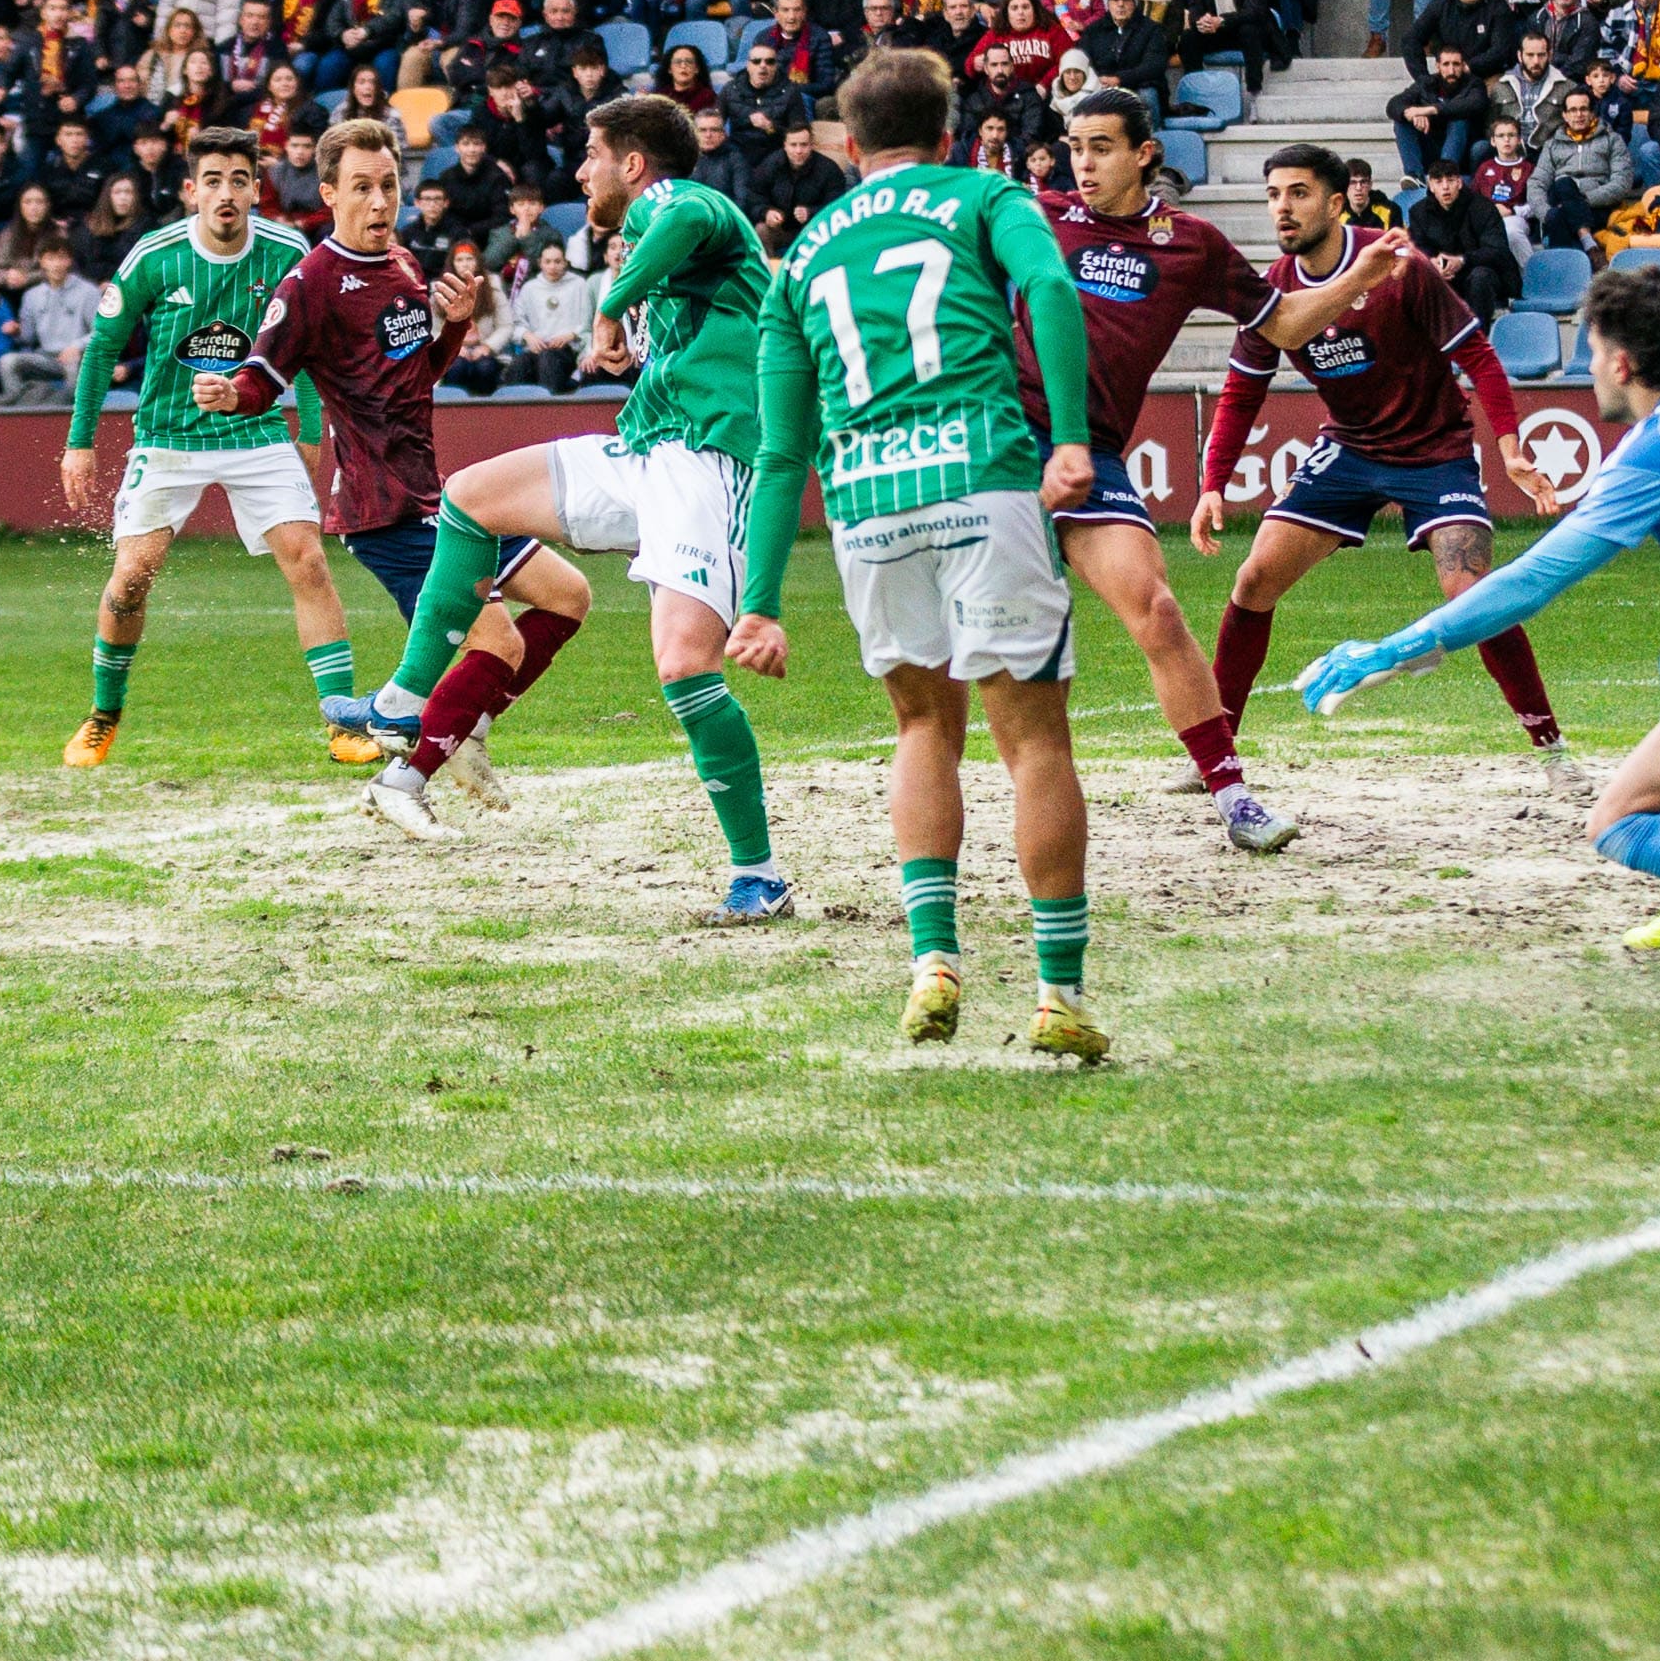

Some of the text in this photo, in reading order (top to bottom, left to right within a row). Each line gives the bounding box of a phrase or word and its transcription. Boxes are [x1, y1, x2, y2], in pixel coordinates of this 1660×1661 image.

[1004, 38, 1051, 59] RVARD
[900, 187, 962, 232] R.A.
[1078, 249, 1147, 275] Estrella
[1078, 264, 1142, 290] Galicia
[384, 308, 427, 332] Estrella
[809, 239, 954, 408] 17
[189, 333, 241, 348] Estrella
[388, 324, 429, 348] Galicia
[1308, 335, 1365, 357] Estrella
[187, 345, 236, 359] Galicia
[1314, 349, 1366, 371] Galicia
[827, 419, 969, 471] Prace
[127, 454, 148, 489] 6
[843, 512, 989, 551] integralmotion
